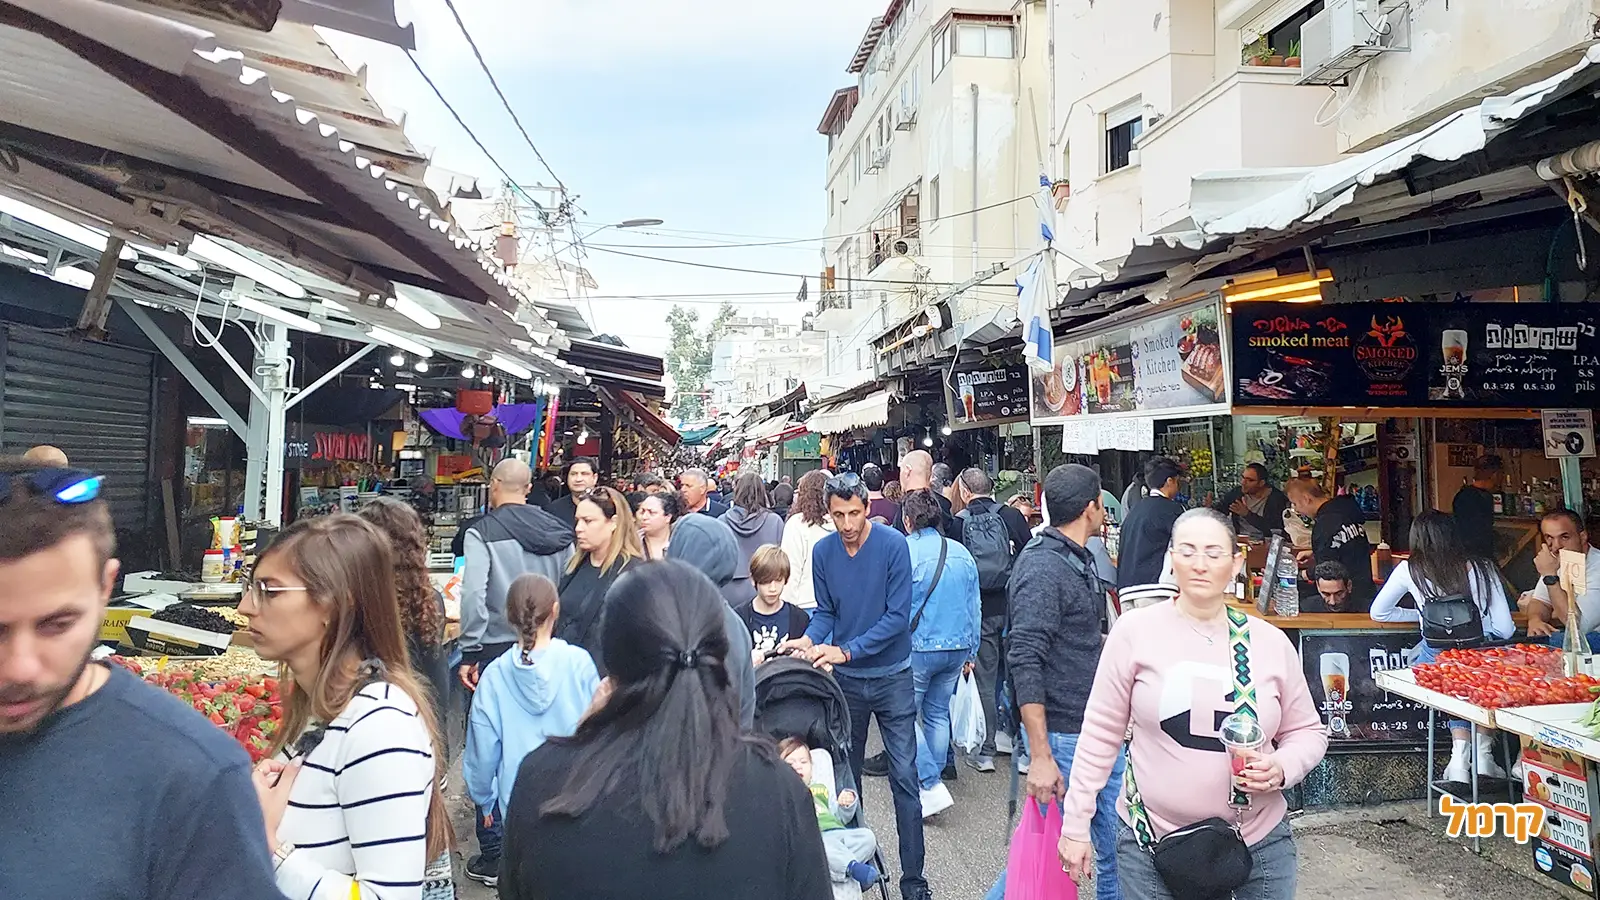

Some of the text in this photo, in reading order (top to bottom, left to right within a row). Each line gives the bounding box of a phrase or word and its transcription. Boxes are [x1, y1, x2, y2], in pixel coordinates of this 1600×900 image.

[1577, 322, 1596, 337] בר
[1144, 331, 1174, 353] Smoked
[1248, 333, 1349, 347] smoked meat
[1356, 346, 1416, 360] SMOKED
[1573, 355, 1600, 366] I.P.A
[1146, 357, 1177, 375] Kitchen
[1575, 380, 1596, 393] pils
[288, 442, 309, 457] STORE
[102, 619, 131, 628] RAISI
[1563, 780, 1585, 799] פירות
[1553, 792, 1587, 814] מובחרים
[1563, 818, 1584, 838] פירות
[1553, 829, 1587, 853] מובחרים
